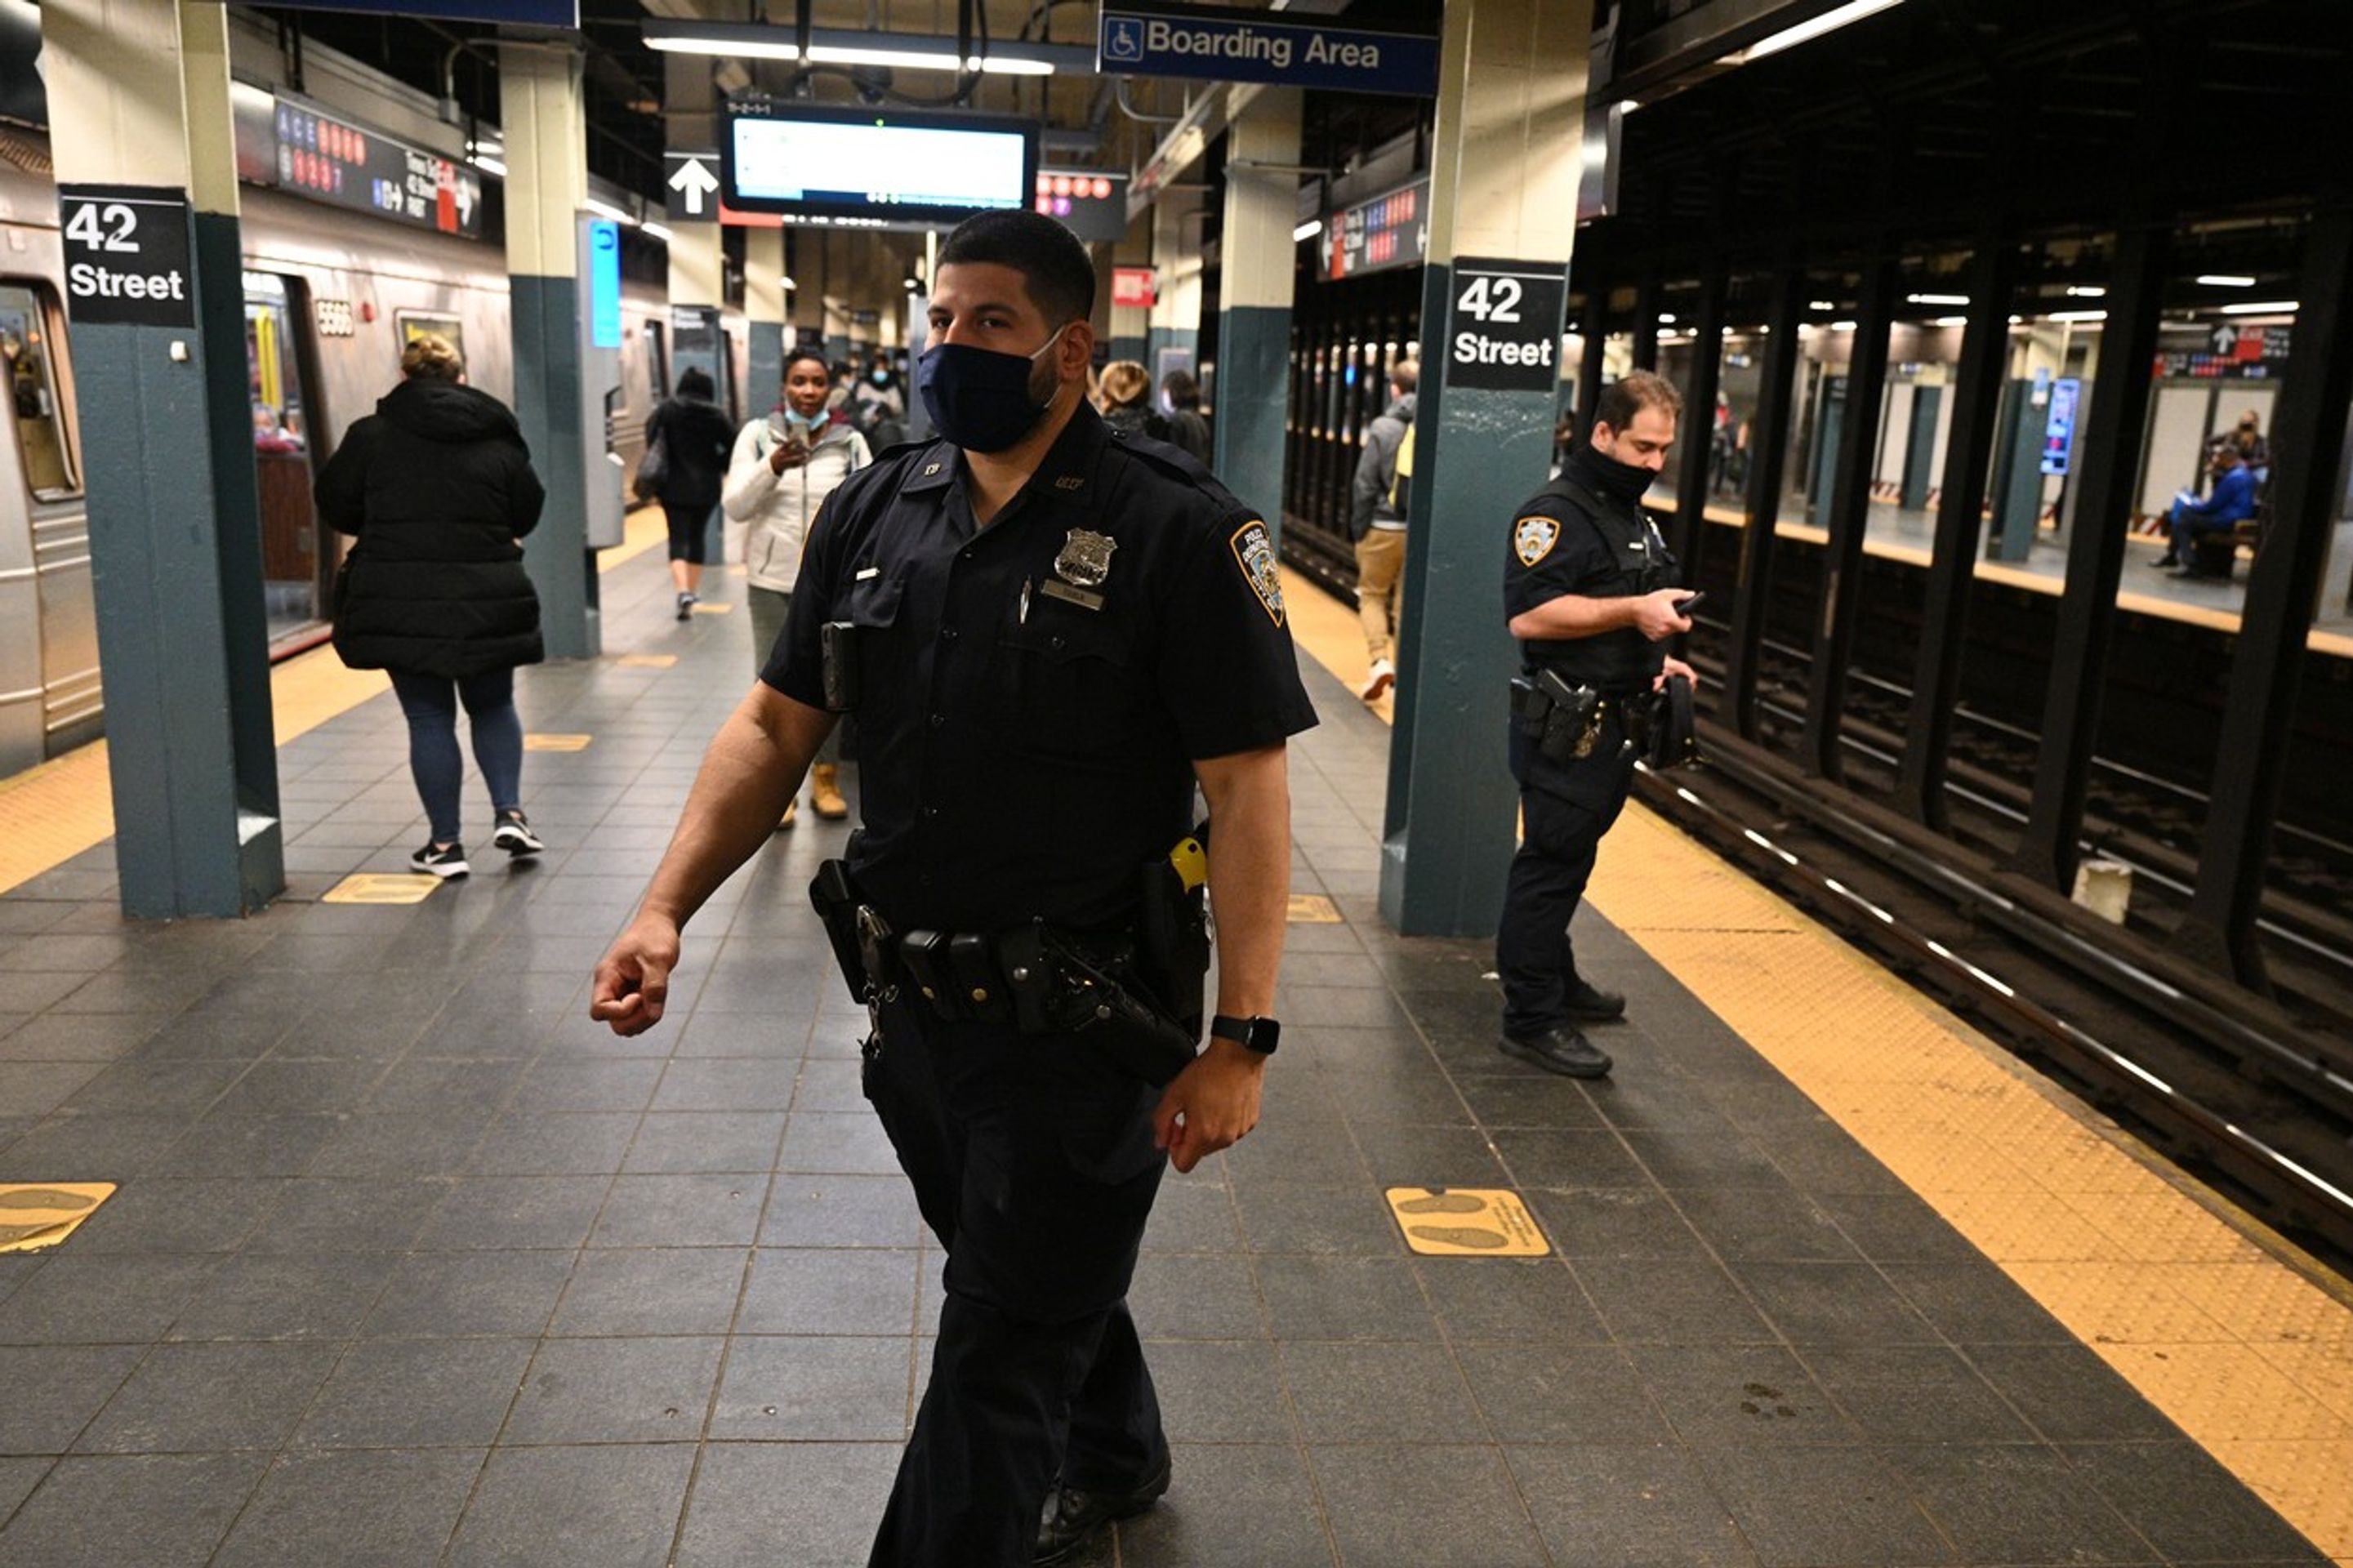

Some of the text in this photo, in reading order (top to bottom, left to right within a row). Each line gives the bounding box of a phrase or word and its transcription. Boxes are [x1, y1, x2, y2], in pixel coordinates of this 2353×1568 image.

[1147, 20, 1379, 69] Boarding Area
[65, 203, 140, 252] 42
[70, 263, 185, 300] Street
[1457, 277, 1522, 323] 42
[1454, 332, 1552, 367] Street
